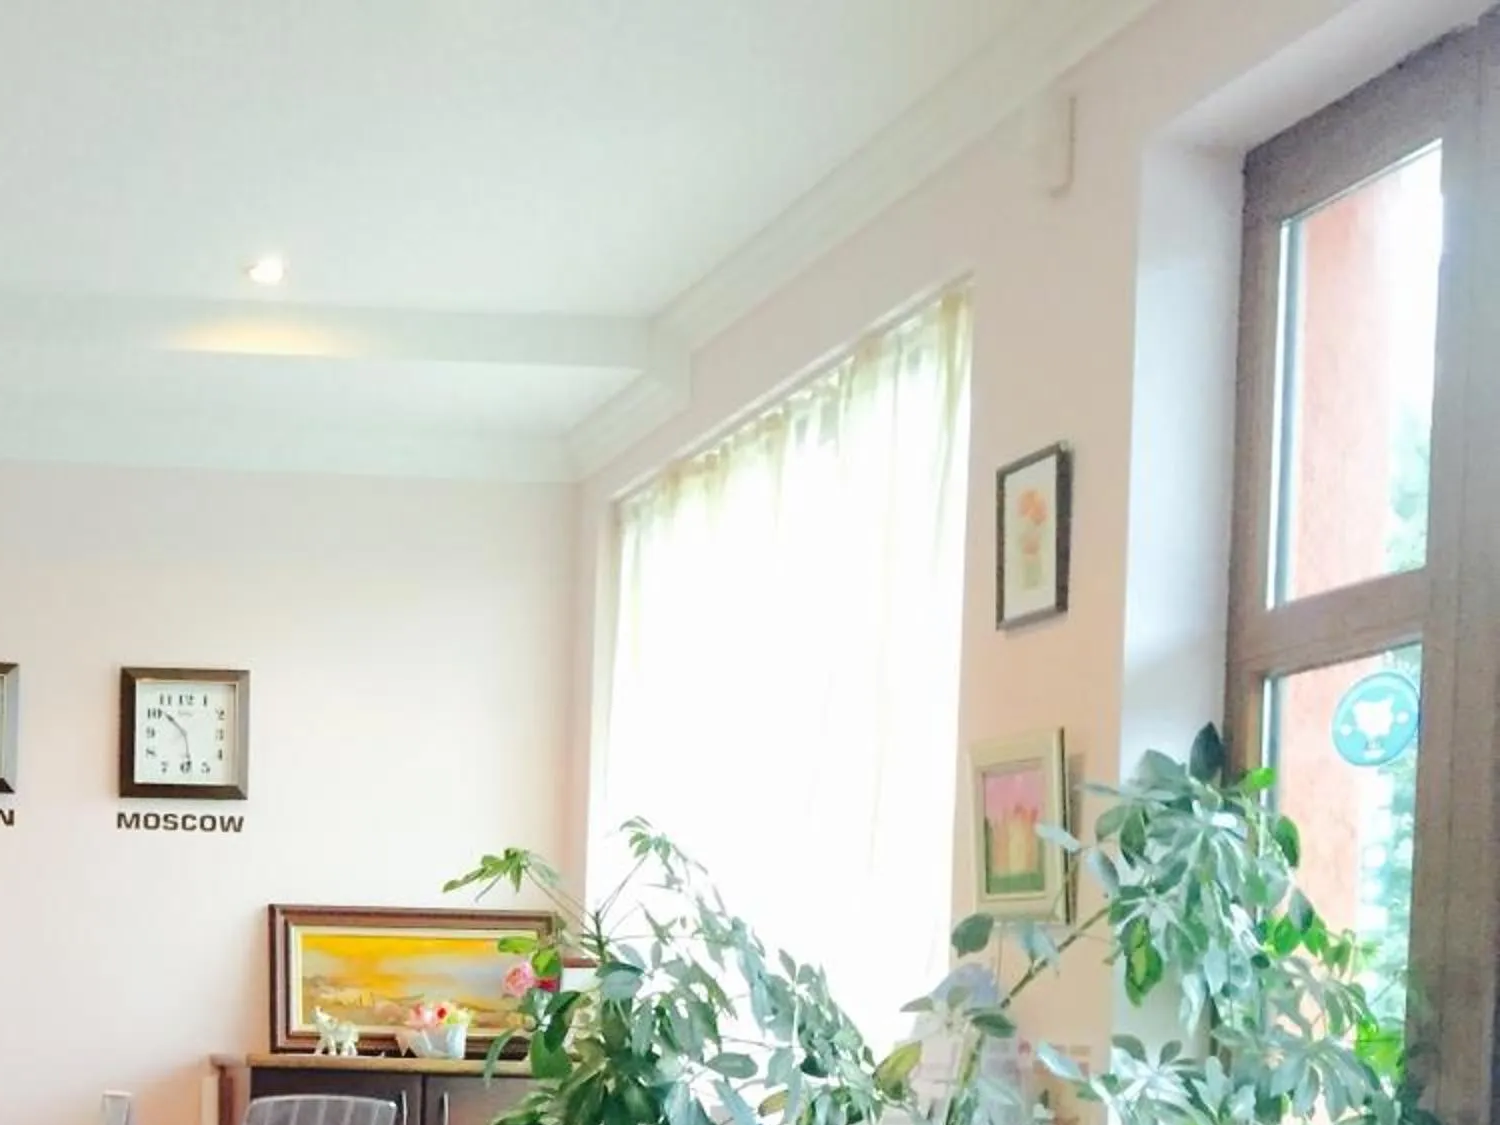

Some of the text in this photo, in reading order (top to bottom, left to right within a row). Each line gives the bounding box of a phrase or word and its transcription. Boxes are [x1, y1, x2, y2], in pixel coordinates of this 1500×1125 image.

[159, 693, 172, 705] 11
[179, 694, 195, 706] 12
[147, 708, 162, 719] 10
[215, 708, 225, 720] 2
[117, 812, 244, 833] MOSCOW
